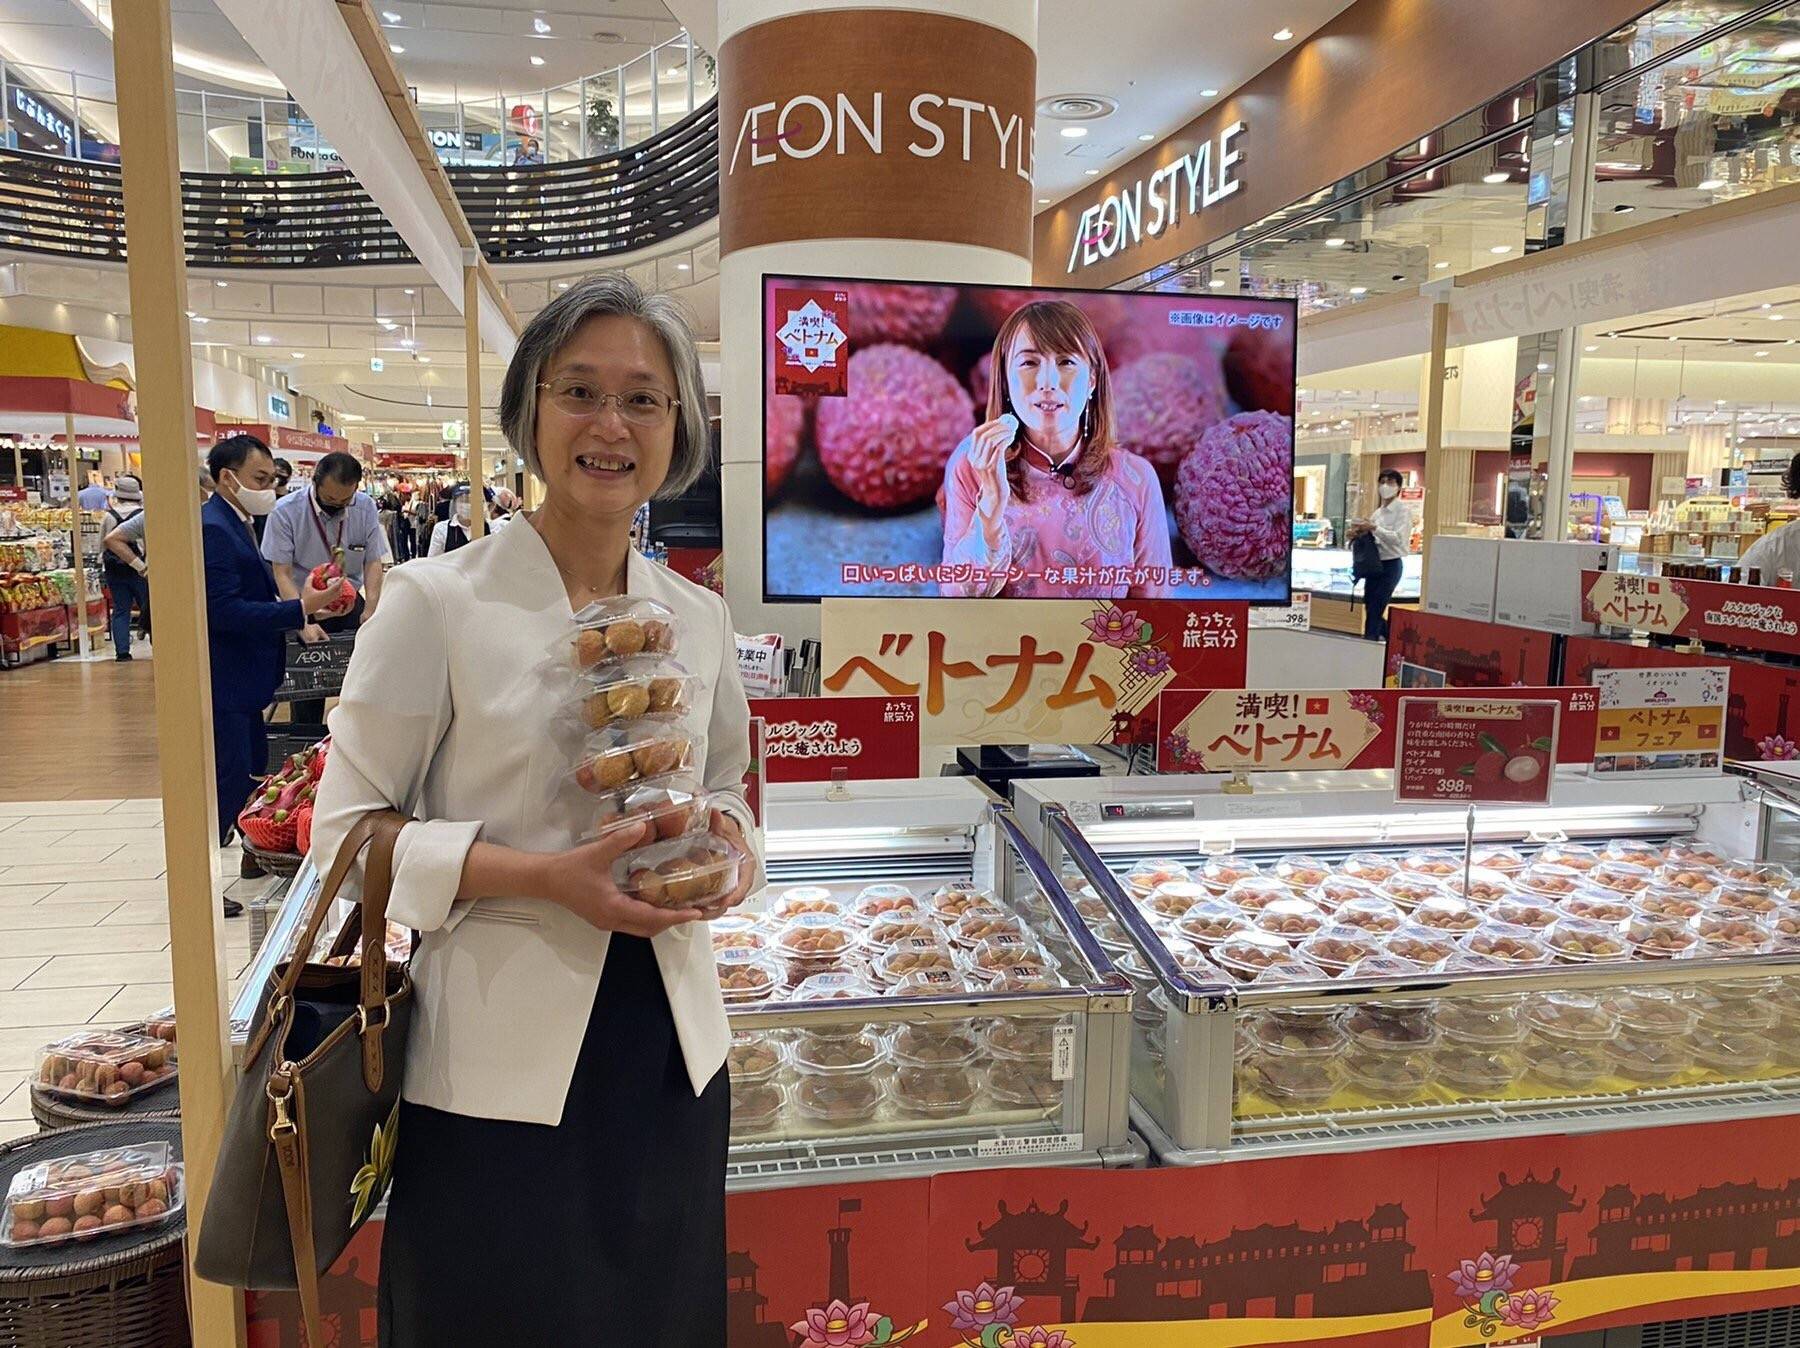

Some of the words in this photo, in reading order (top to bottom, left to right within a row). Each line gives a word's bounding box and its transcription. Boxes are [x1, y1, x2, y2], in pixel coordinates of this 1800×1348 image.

[1146, 120, 1241, 235] STYLE
[784, 329, 839, 345] ベトナム
[842, 565, 1211, 586] 口いっぱいにジューシーな果汁が広がります。
[1602, 596, 1668, 626] ベトナム
[1183, 630, 1238, 649] 旅気分
[823, 630, 1117, 716] ベトナム
[1236, 693, 1299, 719] 満喫!
[1476, 704, 1516, 715] ベトナム
[1629, 709, 1691, 727] ベトナム
[1208, 723, 1341, 763] ベトナム
[1637, 731, 1682, 747] フェア
